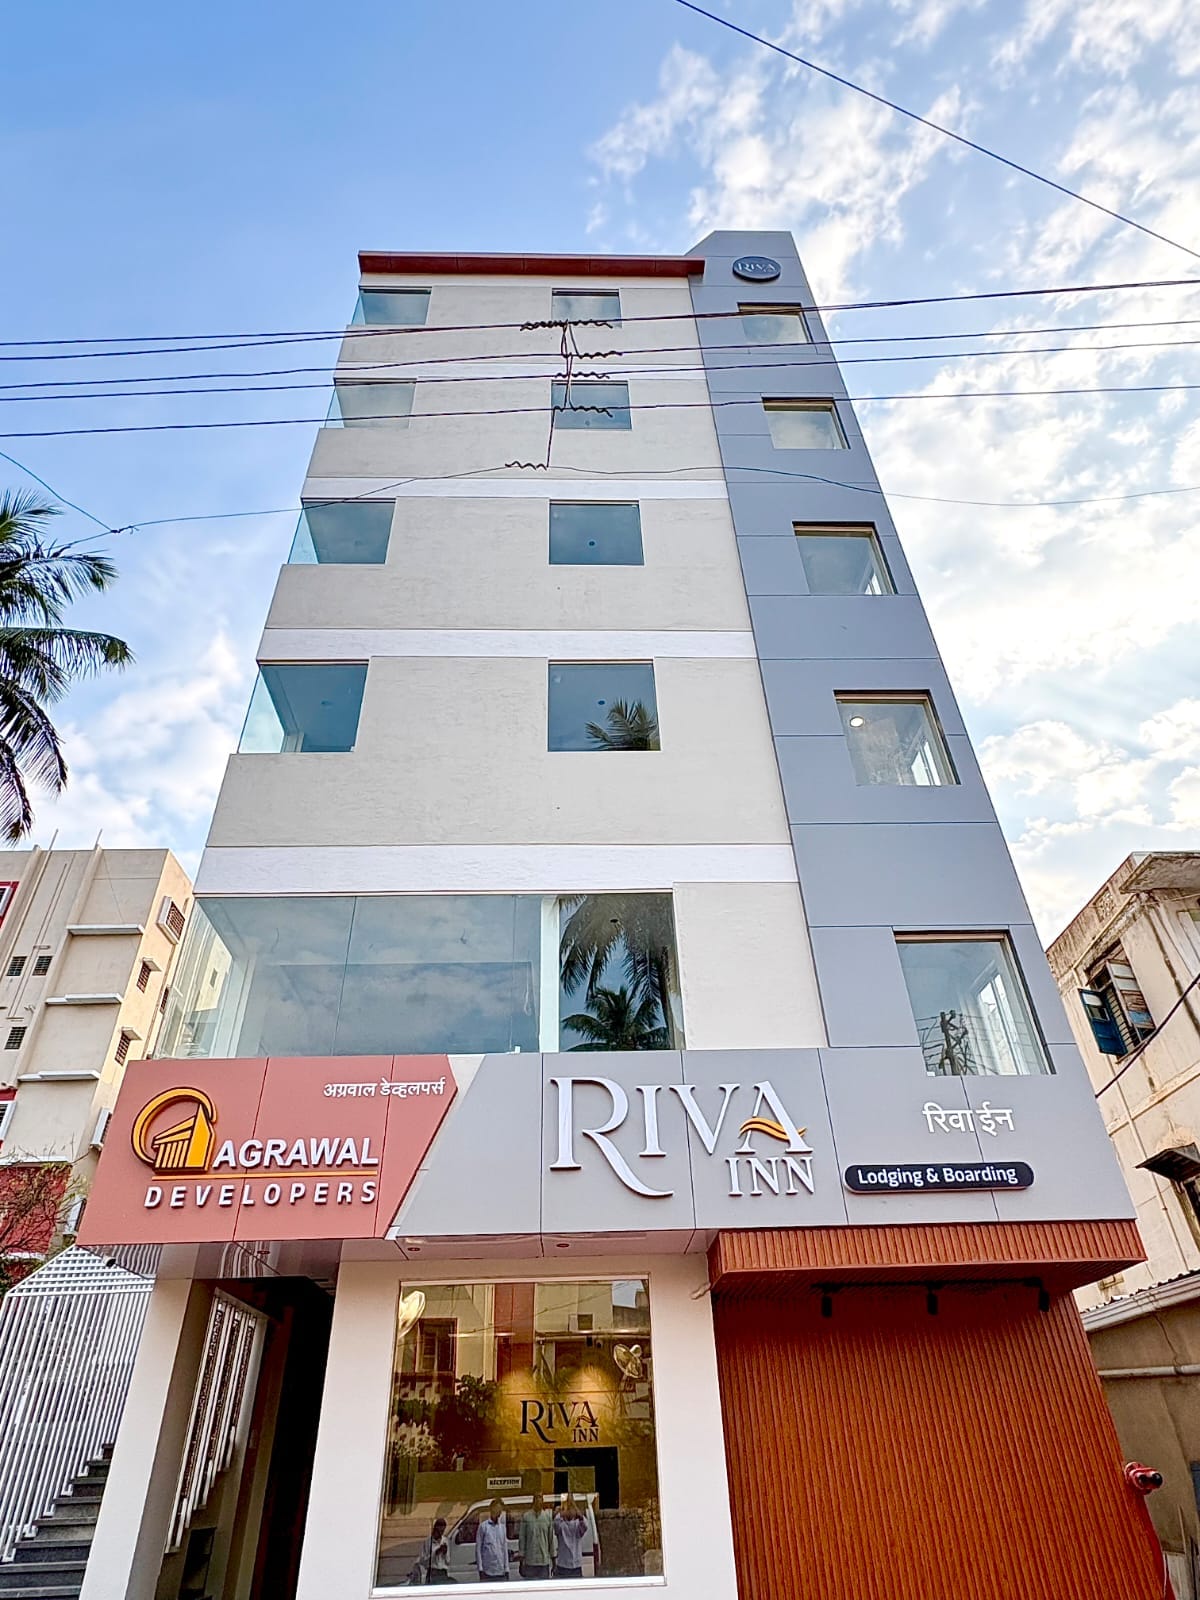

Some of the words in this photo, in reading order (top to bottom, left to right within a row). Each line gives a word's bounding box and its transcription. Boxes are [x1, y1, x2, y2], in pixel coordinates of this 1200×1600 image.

[737, 262, 776, 273] RIVA
[323, 1083, 378, 1098] अग्रवाल
[379, 1077, 446, 1098] डेव्हलपर्स
[922, 1102, 975, 1133] रिवा
[975, 1101, 1015, 1136] ईन
[550, 1077, 814, 1198] RIVA
[212, 1137, 380, 1169] AGRAWAL
[725, 1156, 816, 1197] INN
[857, 1168, 924, 1187] Lodging
[926, 1168, 940, 1183] &
[943, 1166, 1019, 1184] Boarding
[143, 1181, 377, 1208] DEVELOPERS
[519, 1400, 599, 1444] RIVA
[572, 1428, 599, 1443] INN
